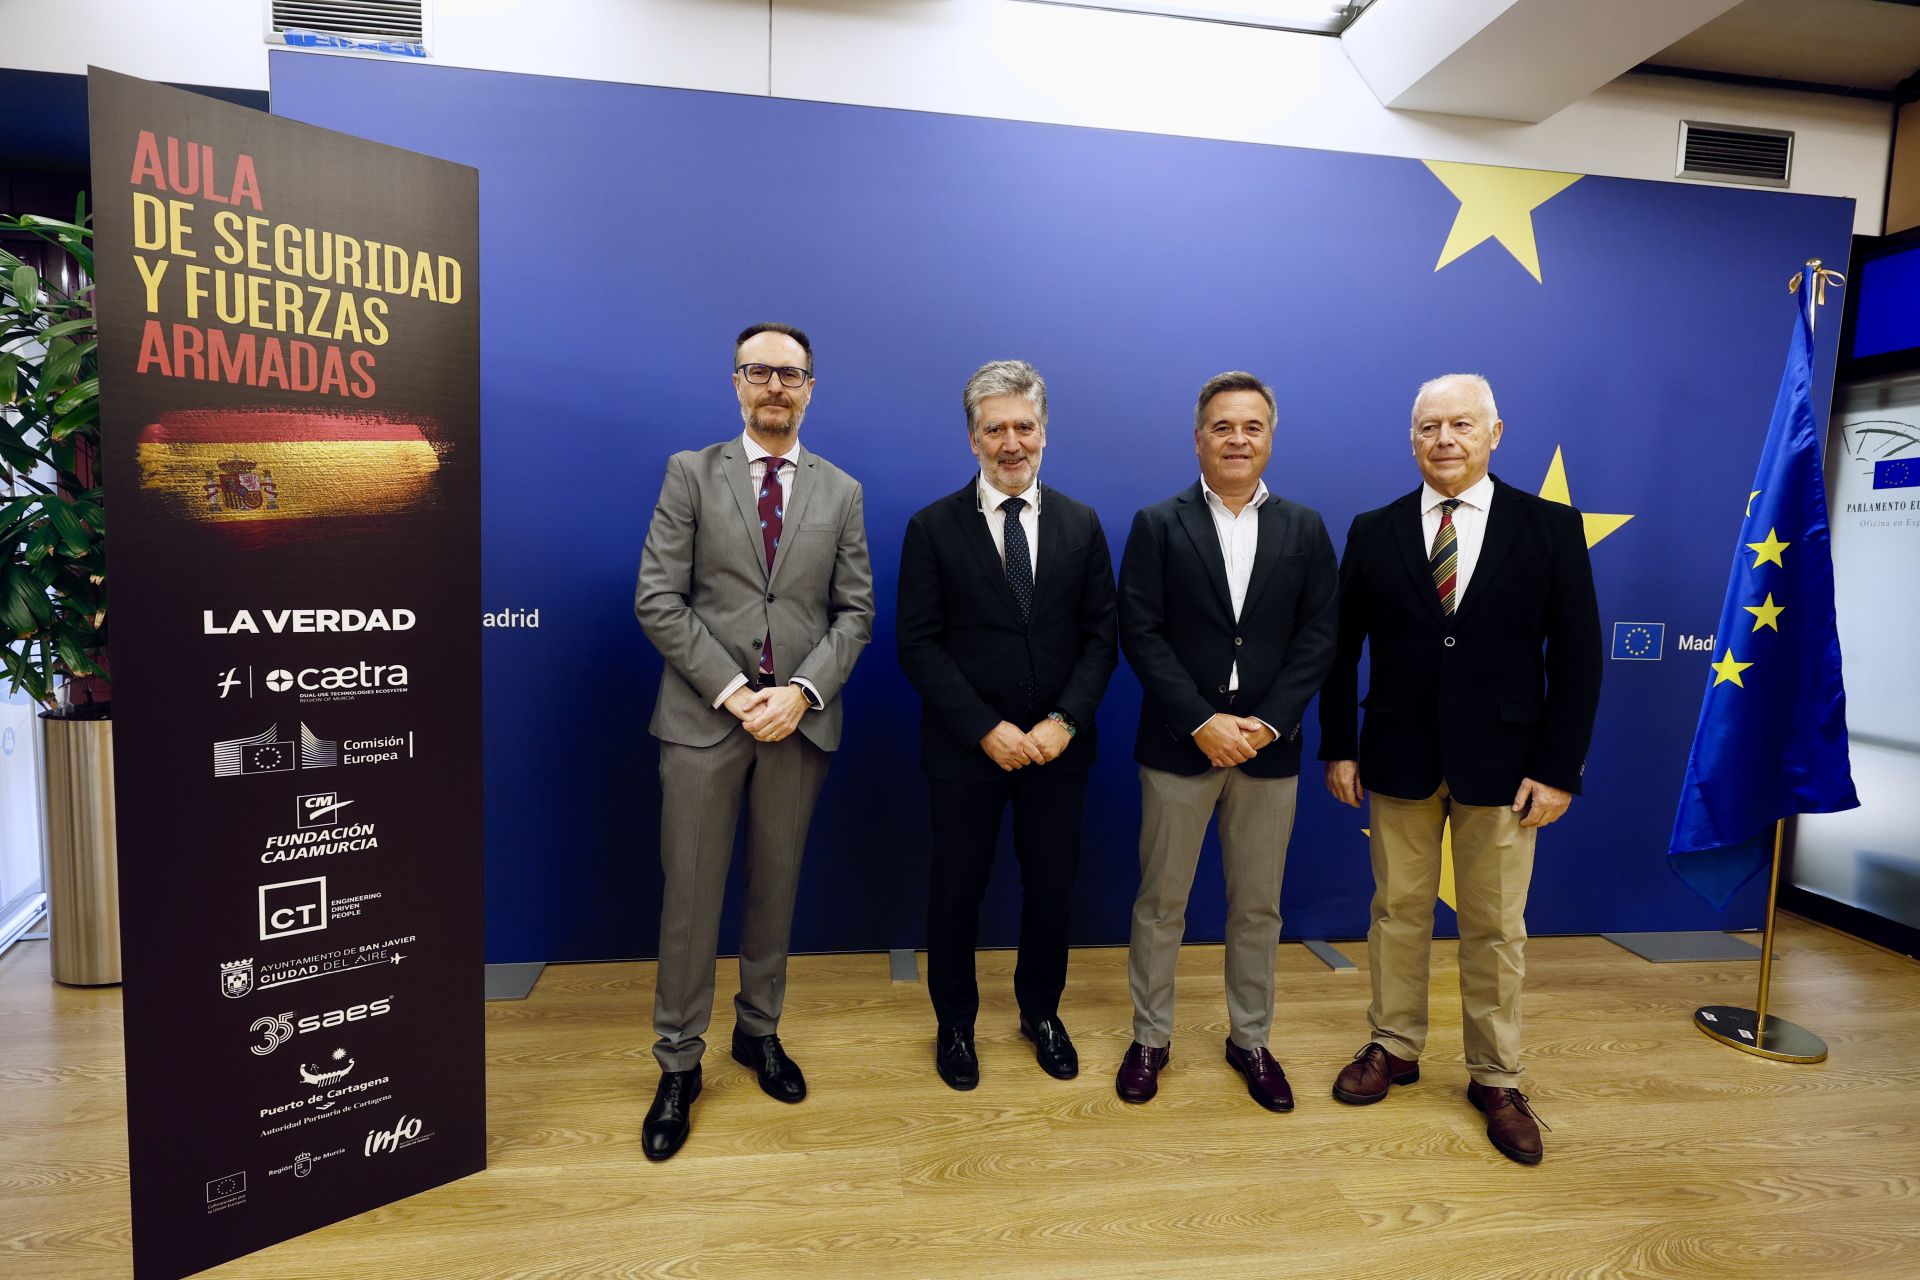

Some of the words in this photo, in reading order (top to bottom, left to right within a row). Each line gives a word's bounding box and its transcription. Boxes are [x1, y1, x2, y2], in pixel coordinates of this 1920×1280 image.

[131, 130, 263, 211] AULA
[133, 192, 197, 258] DE
[213, 210, 462, 305] SEGURIDAD
[133, 255, 169, 313] Y
[185, 264, 389, 346] FUERZAS
[137, 320, 376, 399] ARMADAS
[1847, 501, 1906, 512] PARLAMENTO
[1860, 519, 1889, 528] Oficina
[203, 609, 260, 634] LA
[262, 608, 416, 633] VERDAD
[482, 608, 539, 628] adrid
[297, 660, 408, 691] cætra
[344, 736, 404, 750] Comisión
[344, 752, 398, 764] Europea
[305, 796, 332, 808] CM
[266, 824, 374, 848] FUNDACIÓN
[260, 838, 378, 864] CAJAMURCIA
[331, 892, 382, 906] ENGINEERING
[332, 903, 360, 912] DRIVEN
[270, 904, 316, 930] CT
[332, 910, 361, 920] PEOPLE
[260, 950, 342, 972] AYUNTAMIENTO
[343, 947, 356, 956] DE
[359, 943, 380, 952] SAN
[382, 936, 416, 948] JAVIER
[260, 965, 318, 984] CIUDAD
[324, 959, 350, 970] DEL
[250, 1011, 294, 1056] 35
[298, 998, 391, 1034] saes
[260, 1100, 304, 1118] Puerto
[308, 1094, 324, 1104] de
[327, 1076, 390, 1098] Cartagena
[260, 1120, 302, 1138] Autoridad
[304, 1109, 340, 1124] Portuaria
[342, 1104, 352, 1112] de
[354, 1094, 392, 1109] Cartagena
[364, 1114, 422, 1156] info
[268, 1164, 292, 1176] Región
[322, 1148, 346, 1158] Murcia
